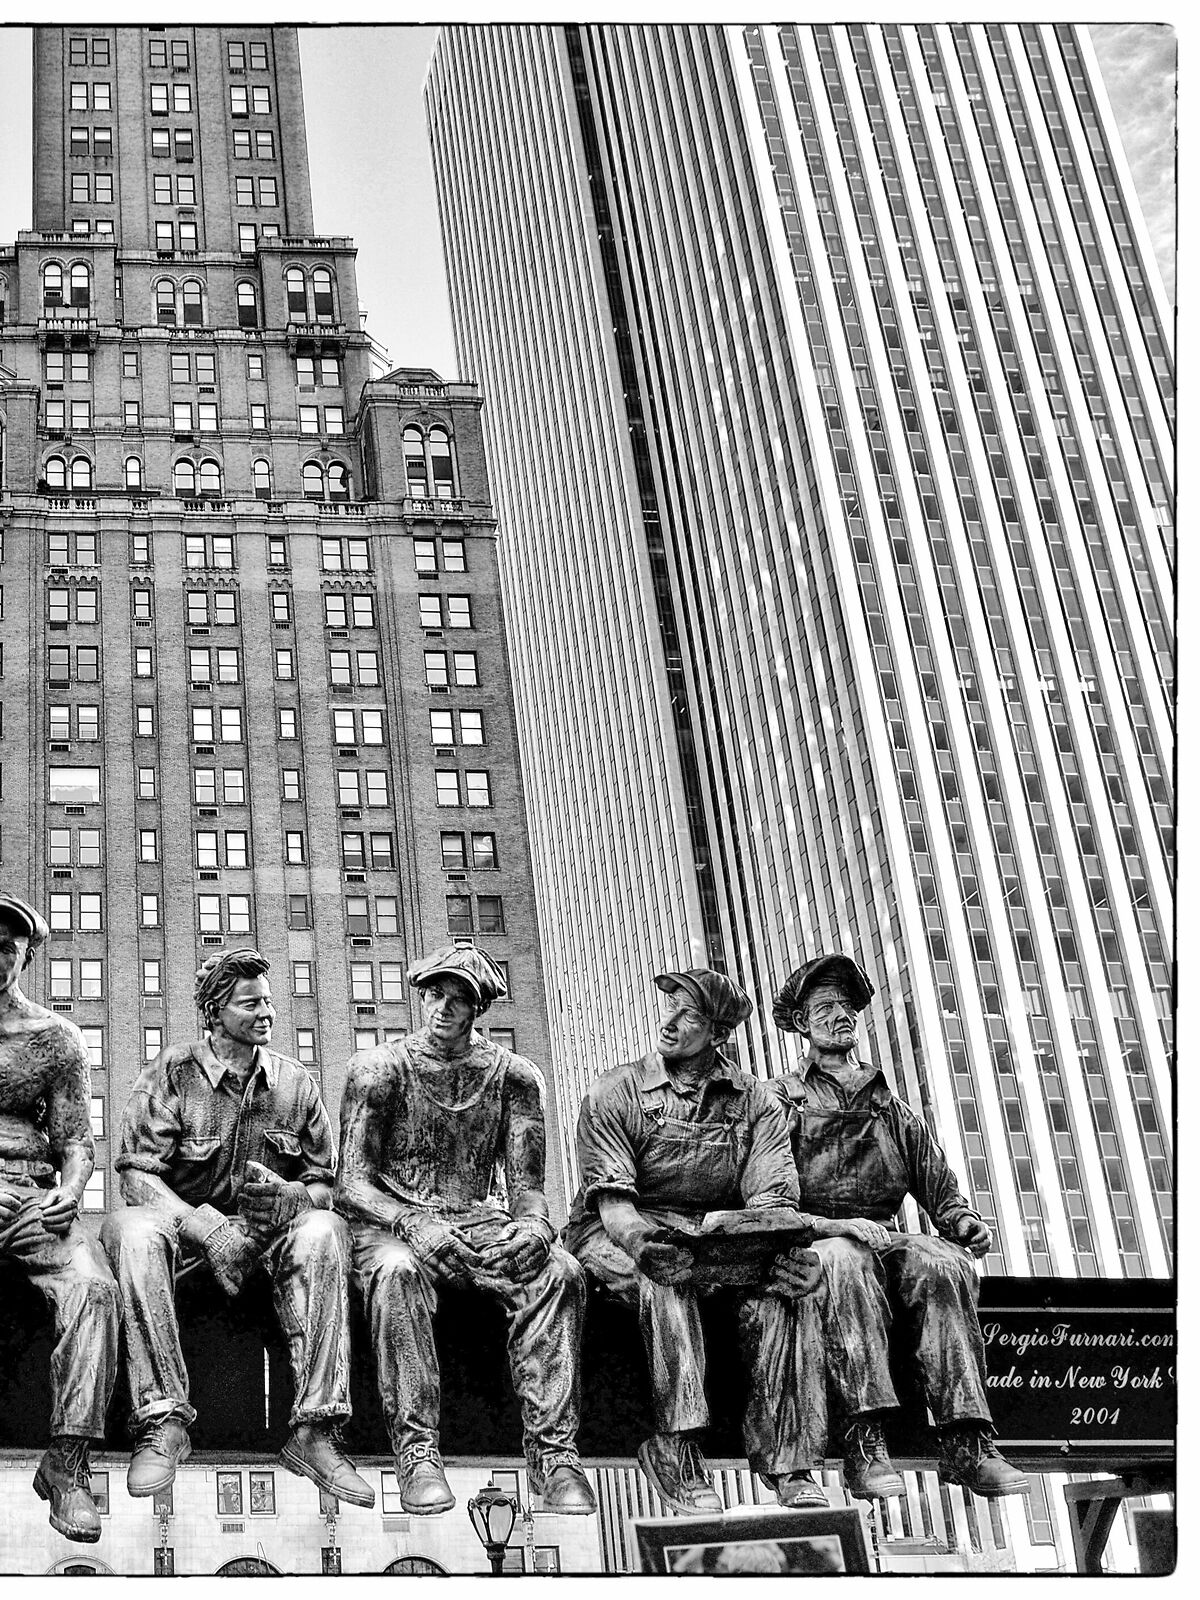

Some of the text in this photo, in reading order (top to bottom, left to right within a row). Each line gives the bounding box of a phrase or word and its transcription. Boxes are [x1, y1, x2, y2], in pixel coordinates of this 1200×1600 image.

[986, 1366, 1024, 1388] ade
[1029, 1369, 1052, 1388] in
[1055, 1365, 1107, 1389] New
[1111, 1365, 1163, 1389] York
[1069, 1407, 1121, 1425] 2001
